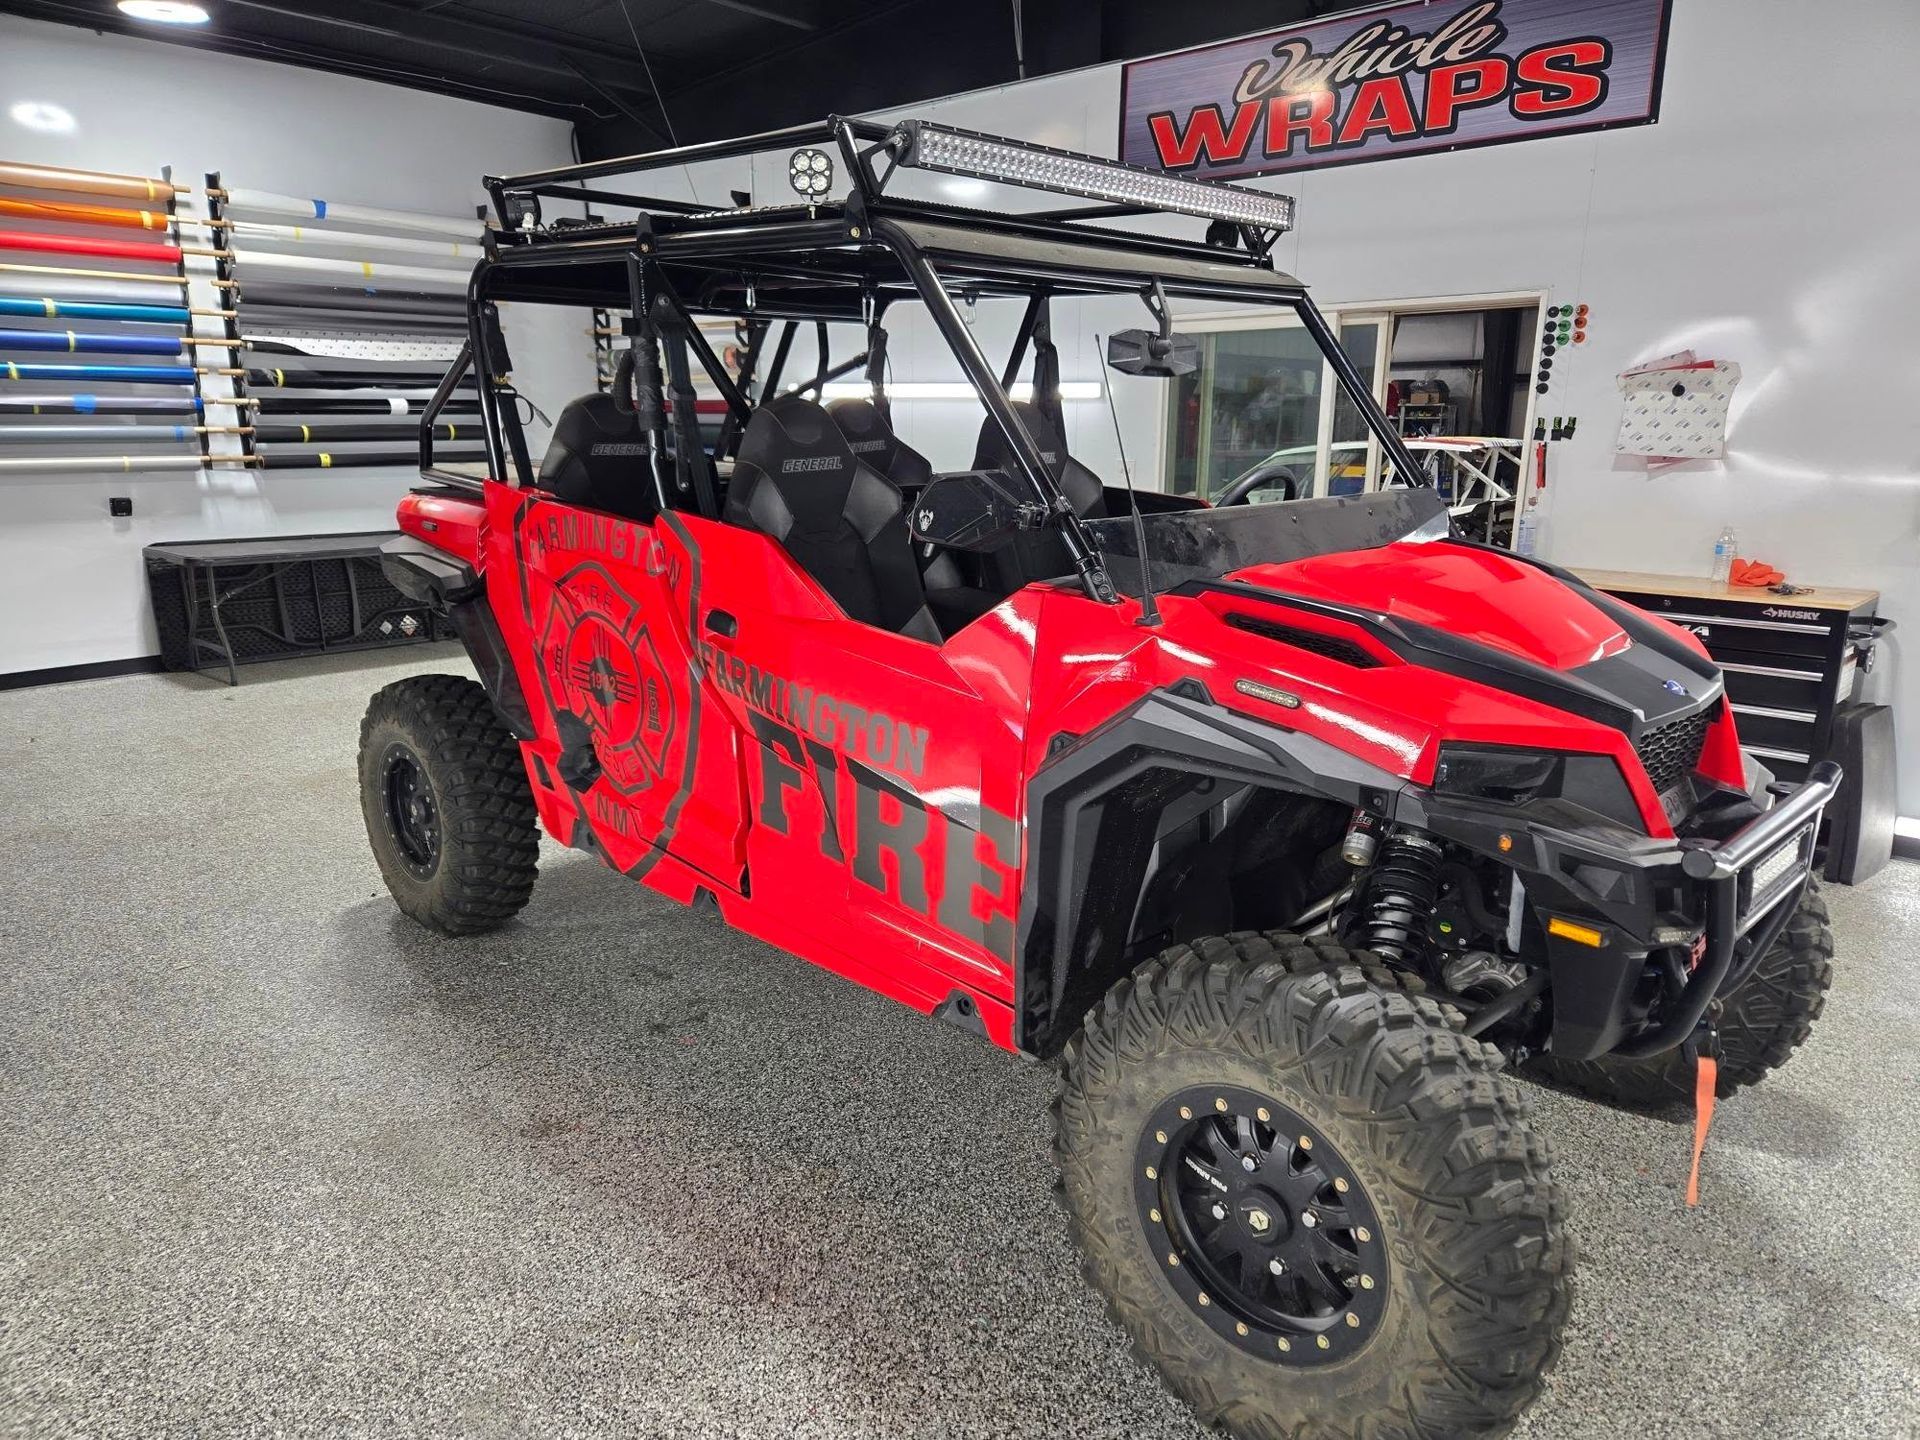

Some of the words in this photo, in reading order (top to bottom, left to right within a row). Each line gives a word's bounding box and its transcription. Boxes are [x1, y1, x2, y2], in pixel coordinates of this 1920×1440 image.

[1235, 1, 1503, 103] Vehicle
[1149, 41, 1605, 168] WRAPS
[782, 456, 843, 473] GENERAL
[1778, 608, 1821, 621] HUSKY
[700, 641, 929, 777] FARMINGTON
[597, 791, 628, 837] NM
[747, 705, 1021, 967] FIRE
[1185, 1156, 1210, 1180] ARMOR
[1210, 1177, 1228, 1192] PRO
